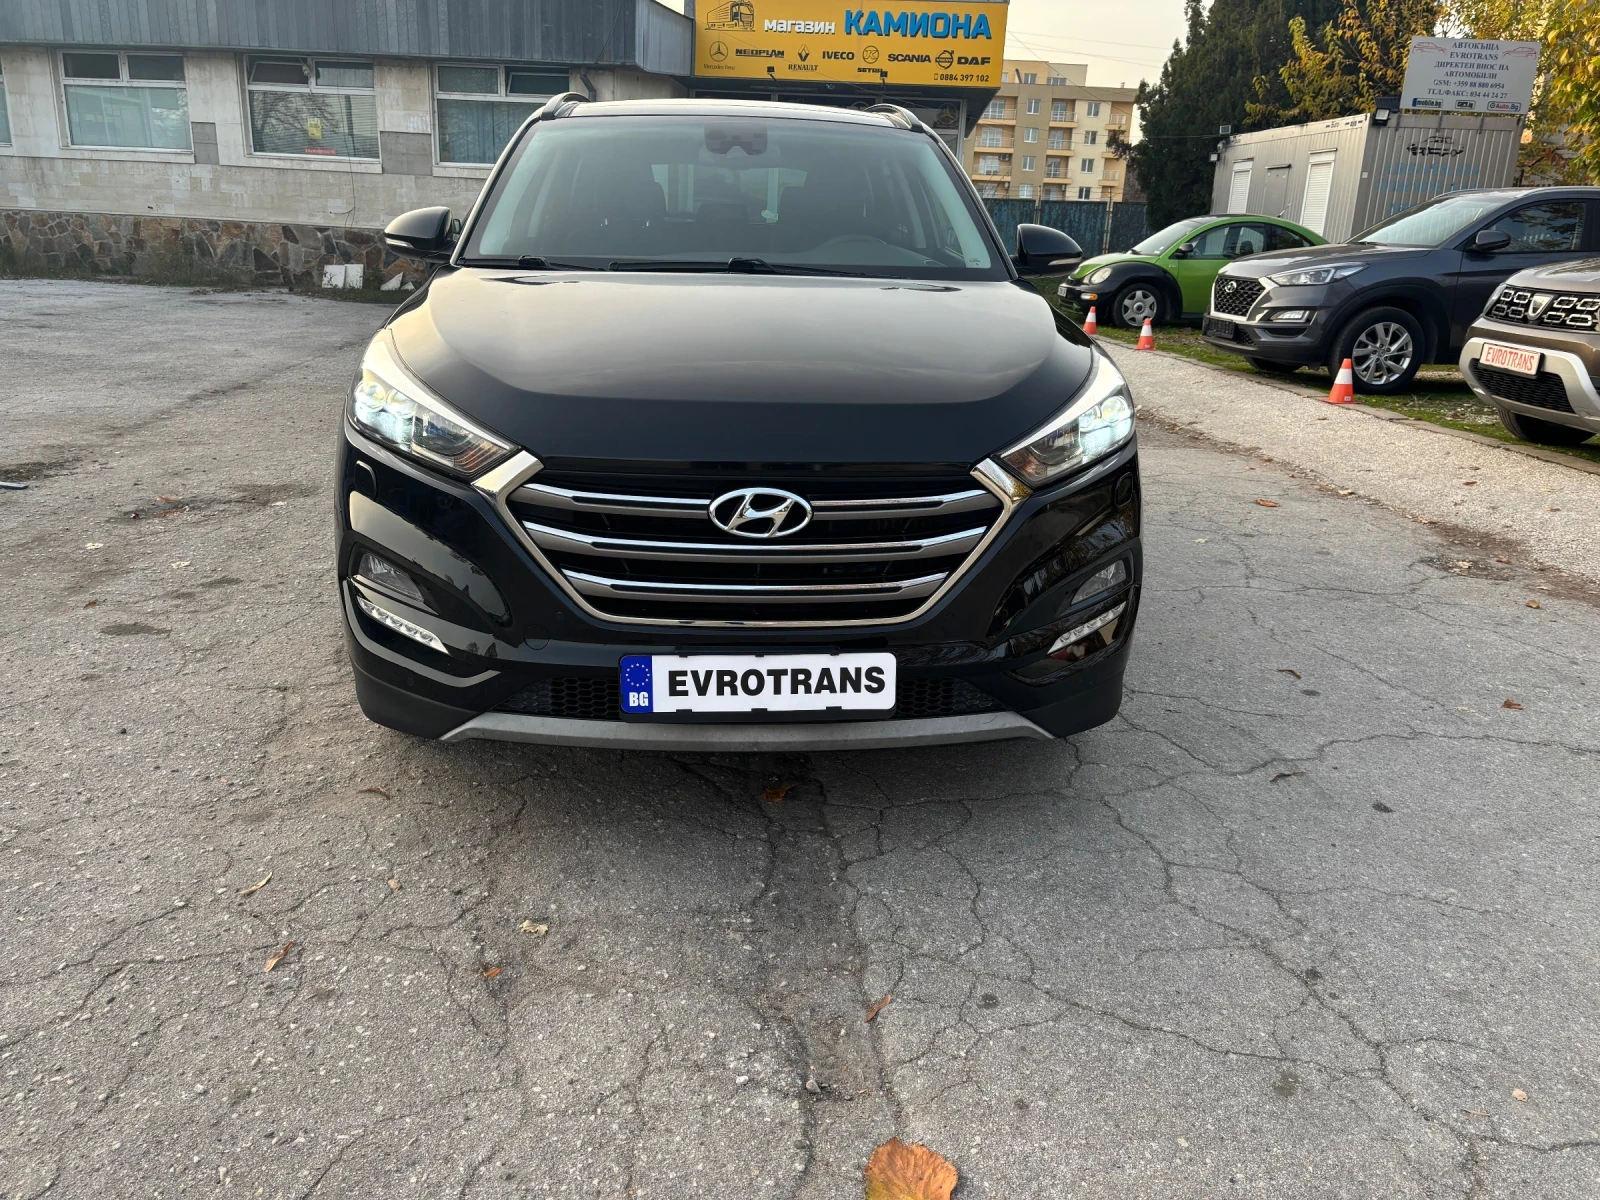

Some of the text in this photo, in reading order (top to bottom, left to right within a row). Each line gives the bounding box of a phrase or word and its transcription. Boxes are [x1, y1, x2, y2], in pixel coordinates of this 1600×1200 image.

[764, 10, 992, 40] магазин КАМИОНА
[1452, 42, 1500, 51] АВТОКЪЩА
[735, 48, 784, 58] NEOPLAN
[822, 50, 855, 60] IVECO
[888, 53, 932, 63] SCANIA
[1450, 52, 1498, 60] EVROTRANS
[957, 56, 991, 66] DAF
[1434, 61, 1475, 69] ДИРЕКТЕН
[1444, 71, 1497, 79] АВТОМОБИЛИ
[1485, 346, 1535, 371] EVROTRANS
[668, 666, 886, 697] EVROTRANS
[629, 691, 648, 707] BG
